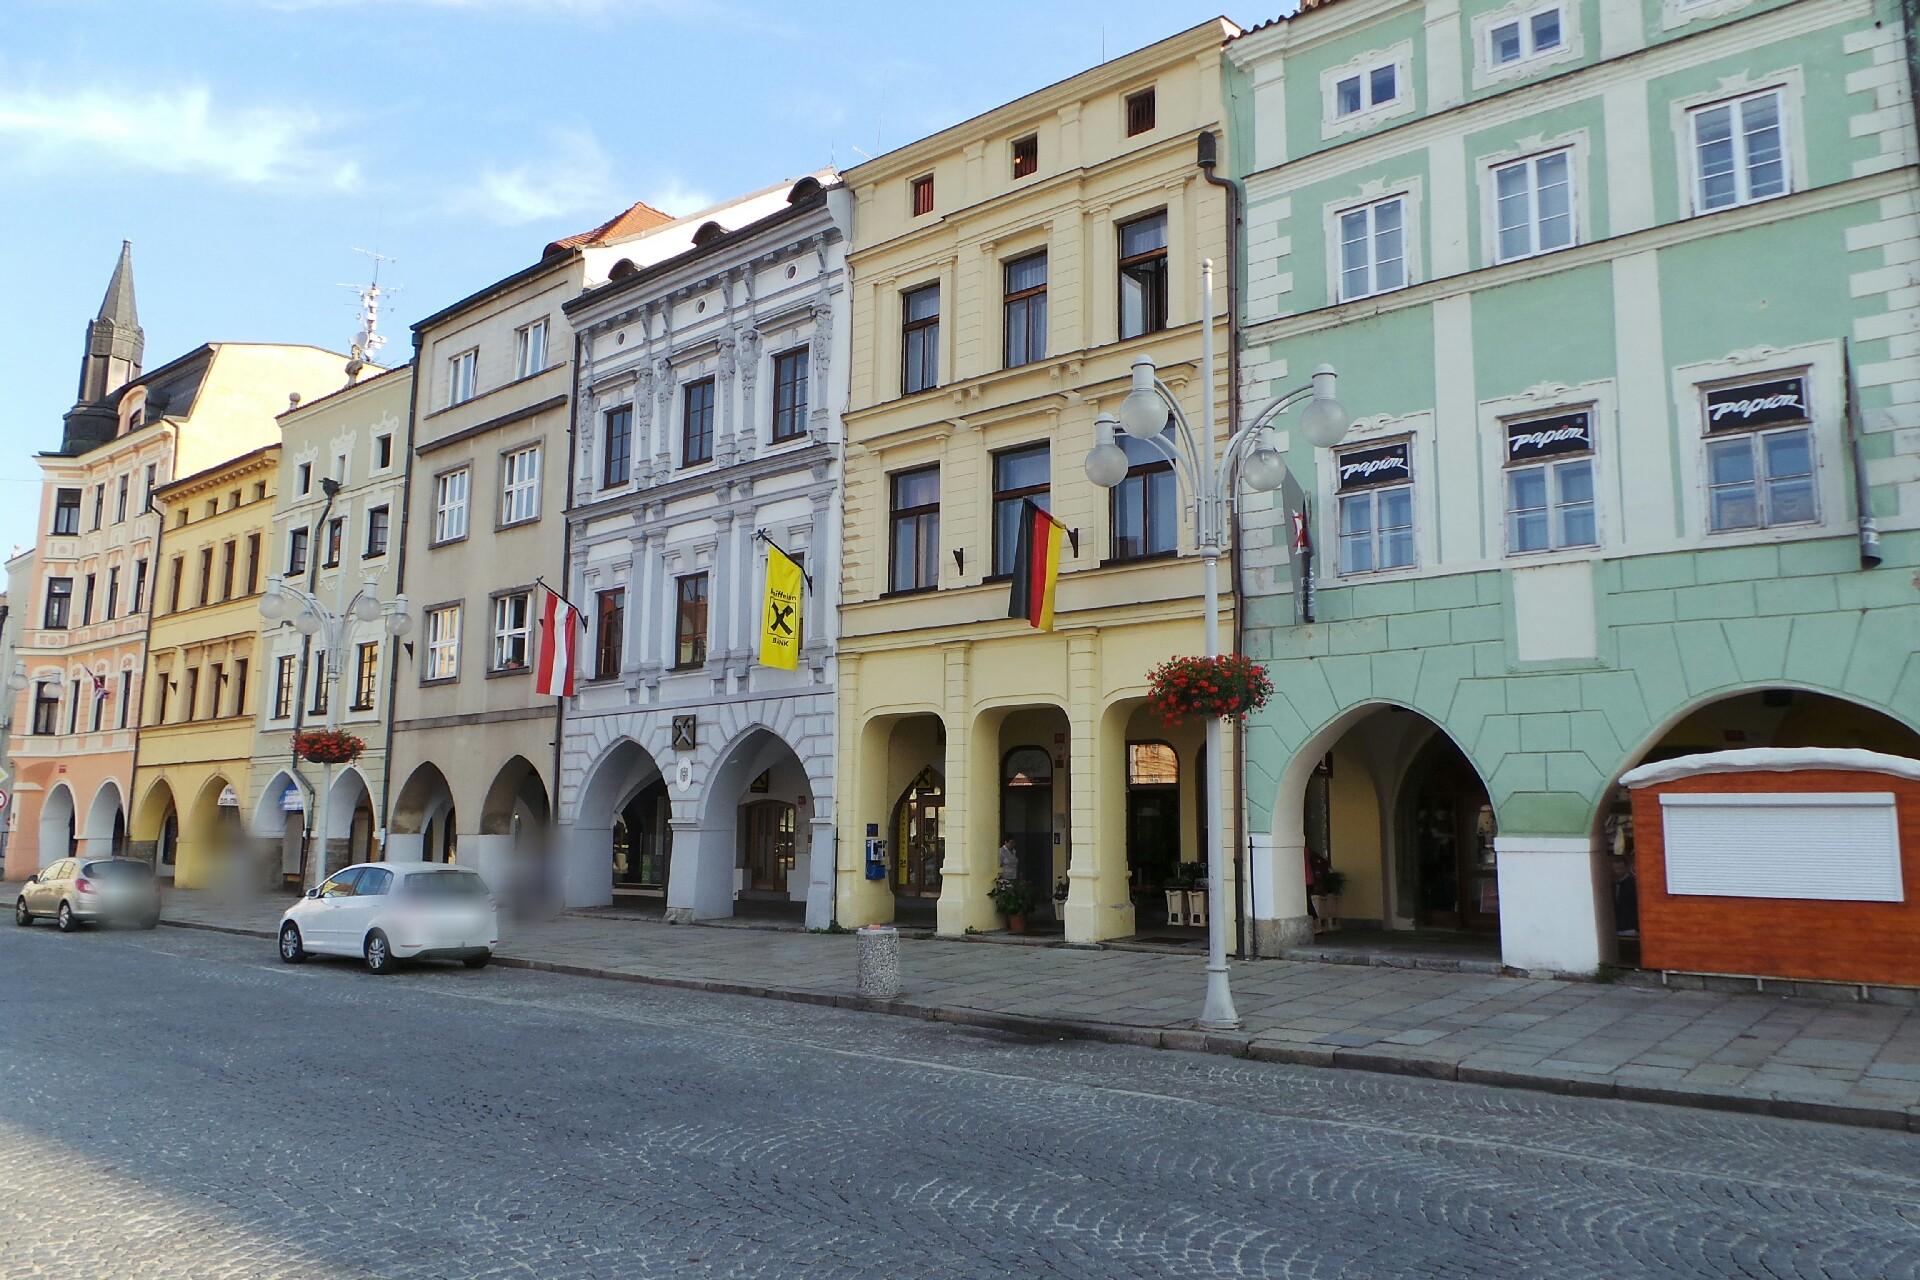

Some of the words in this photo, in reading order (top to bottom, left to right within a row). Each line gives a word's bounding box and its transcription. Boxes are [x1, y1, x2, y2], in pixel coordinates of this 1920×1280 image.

[1707, 393, 1804, 421] papion
[1508, 425, 1589, 452] papion
[1340, 456, 1408, 480] papion
